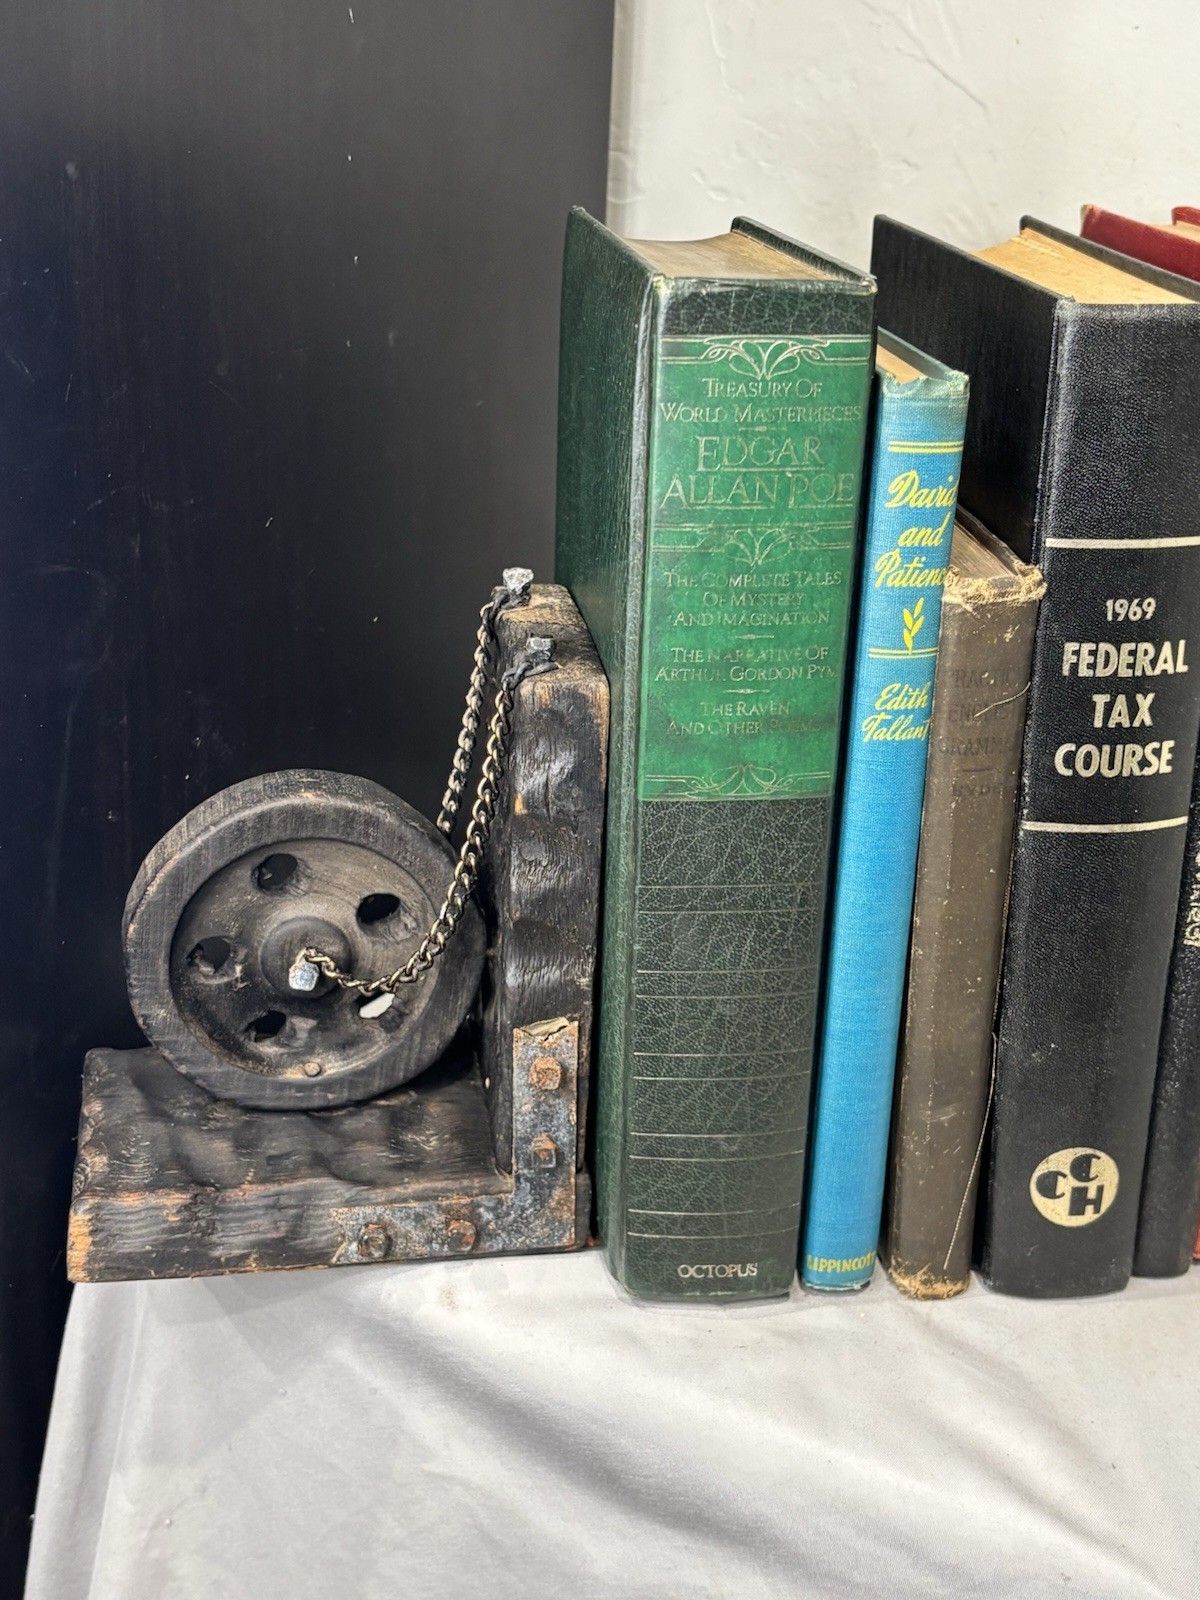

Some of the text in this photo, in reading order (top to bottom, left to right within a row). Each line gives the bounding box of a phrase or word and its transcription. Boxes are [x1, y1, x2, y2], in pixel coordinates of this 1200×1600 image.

[701, 378, 792, 398] TREASURY
[660, 402, 862, 423] WORLD MASTERPIECES
[697, 436, 825, 472] EDGAR
[660, 473, 855, 510] ALLAN POE
[884, 470, 960, 508] David
[897, 512, 952, 547] and
[664, 571, 842, 588] THE COMPLETE TALES
[874, 548, 948, 588] Patienc
[730, 592, 806, 607] MYSTERY
[1105, 597, 1156, 622] 1969
[672, 611, 831, 627] AND IMAGINATION
[670, 646, 704, 663] THE
[1061, 639, 1189, 678] FEDERAL
[730, 665, 803, 681] GORDON
[700, 700, 791, 717] THE RAVEN
[874, 681, 932, 711] Edith
[1092, 692, 1156, 729] TAX
[666, 721, 704, 736] AND
[707, 719, 763, 735] OTHER
[861, 712, 932, 743] Tallant
[1054, 739, 1176, 778] COURSE
[677, 1262, 759, 1278] OCTOPUS
